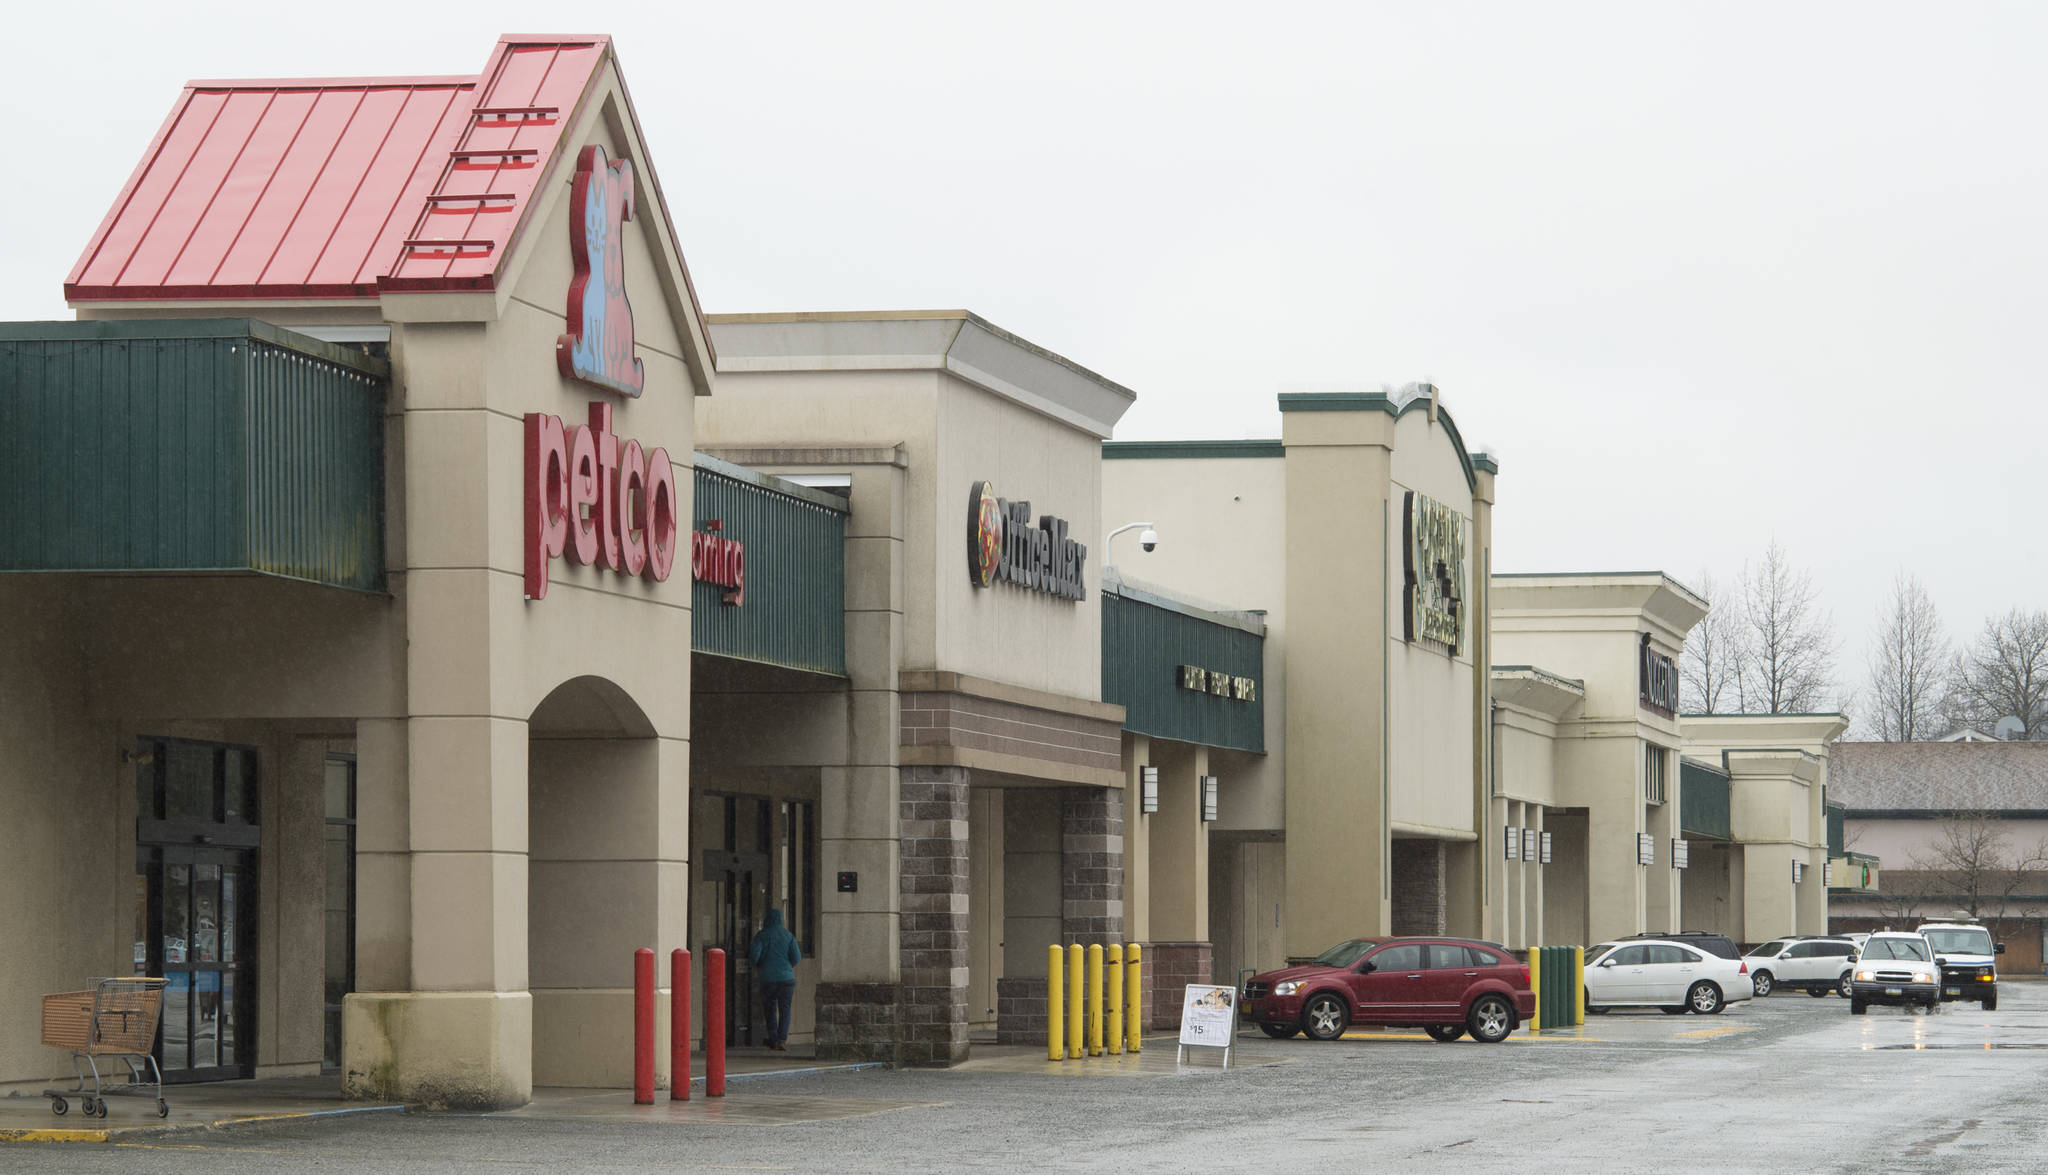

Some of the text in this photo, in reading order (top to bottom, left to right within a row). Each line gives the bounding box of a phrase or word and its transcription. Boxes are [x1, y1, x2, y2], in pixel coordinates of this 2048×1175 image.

[524, 401, 677, 600] petco
[997, 497, 1087, 602] OfficeMax
[692, 519, 744, 607] oming
